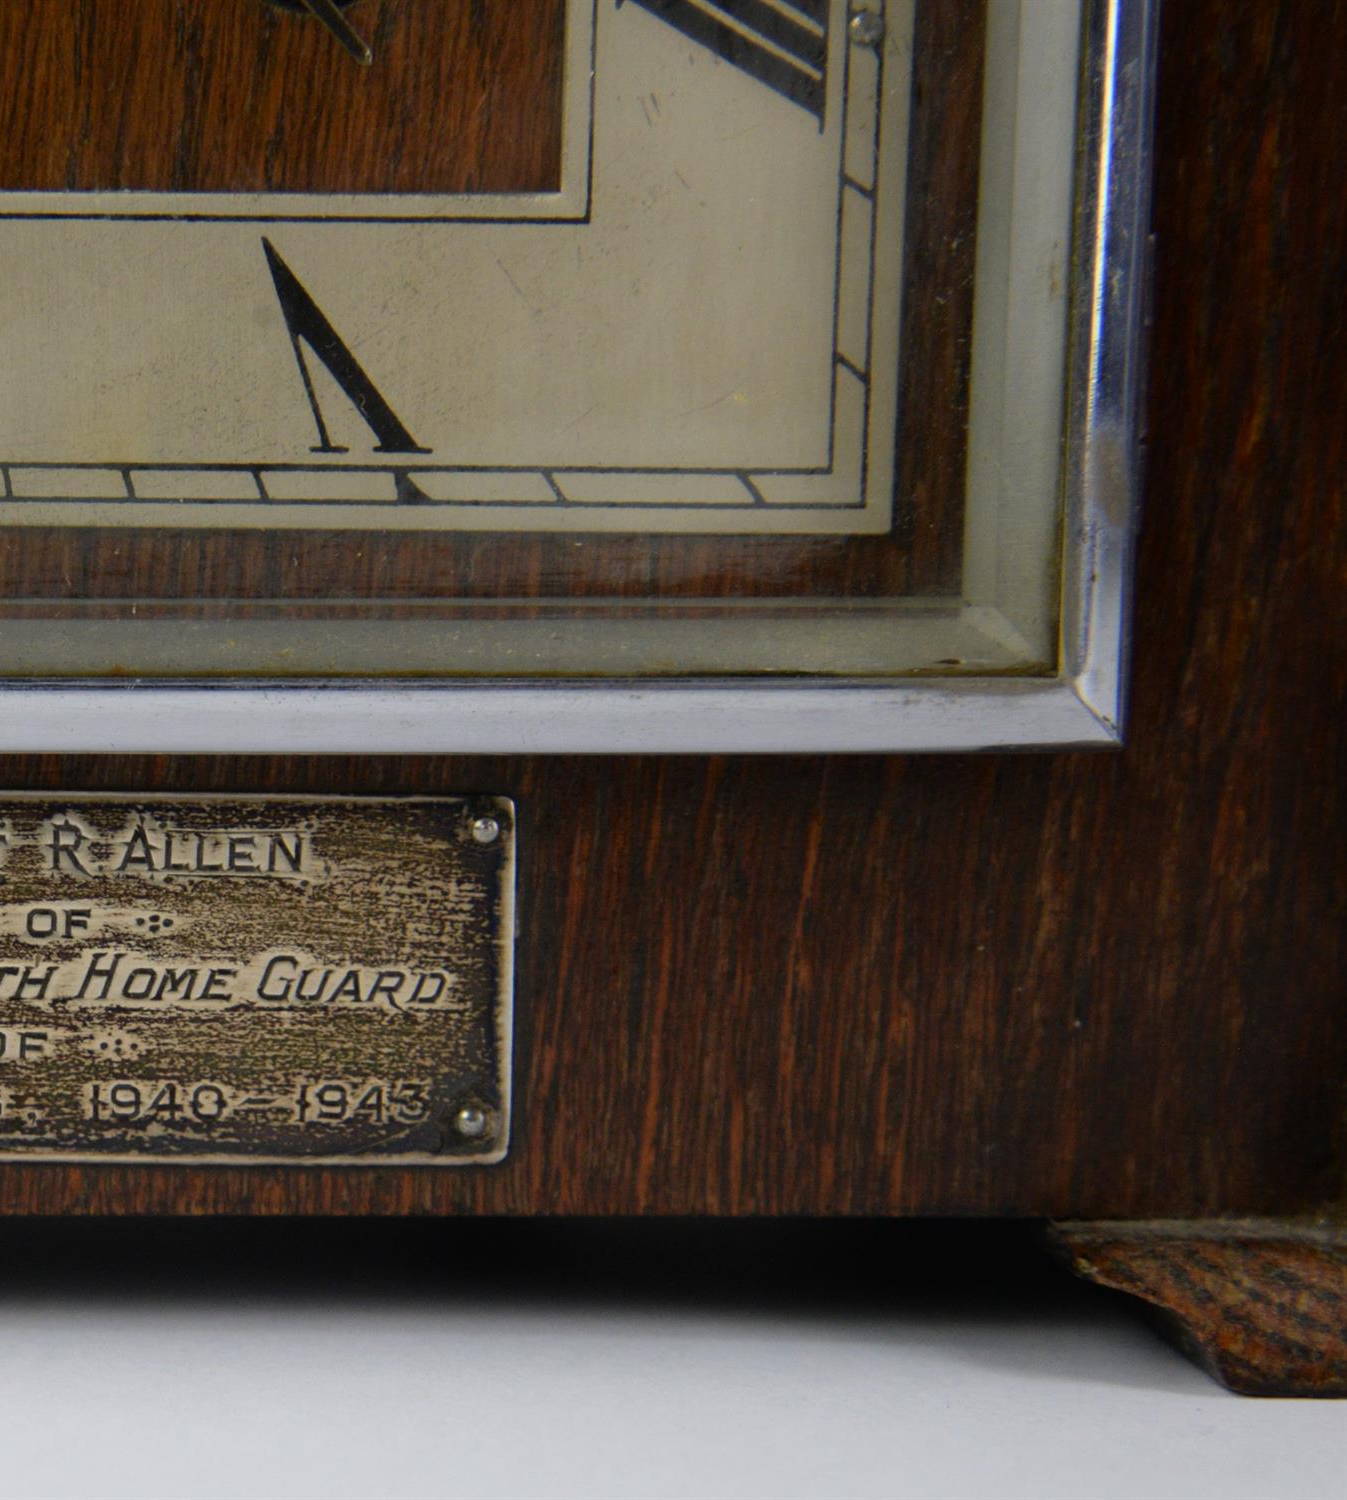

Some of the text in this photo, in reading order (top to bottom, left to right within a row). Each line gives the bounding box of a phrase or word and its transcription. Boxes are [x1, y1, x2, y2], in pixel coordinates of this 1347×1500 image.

[26, 908, 91, 938] OF
[76, 952, 237, 1002] HOME
[256, 954, 450, 1010] GUARD
